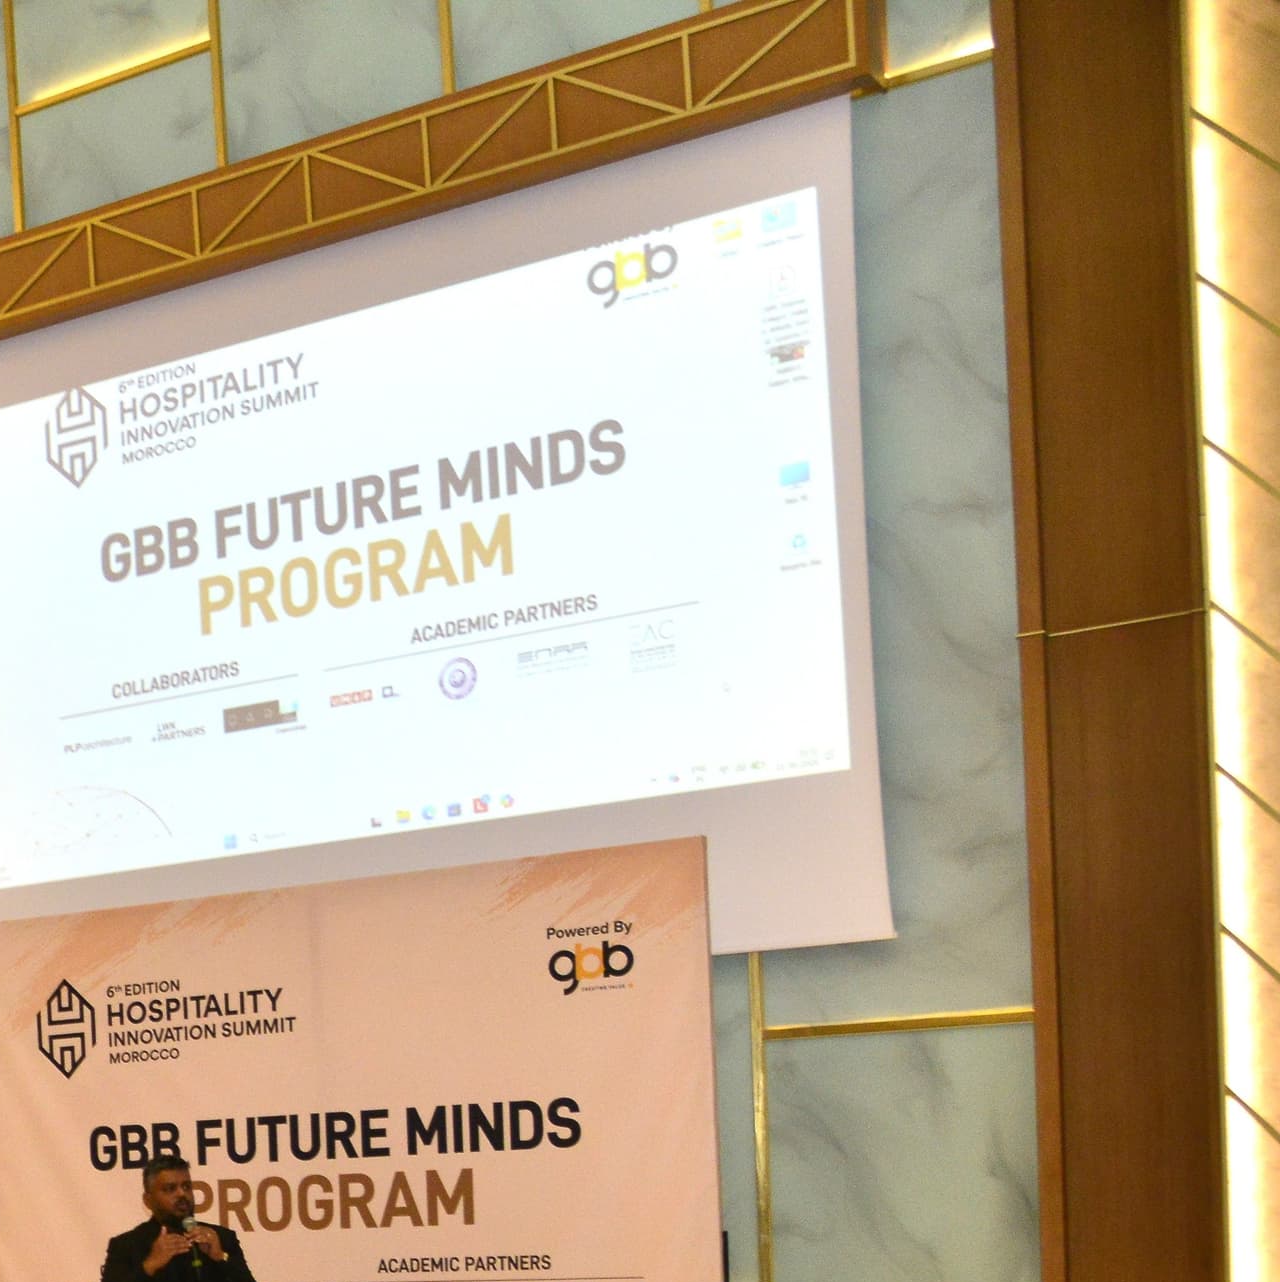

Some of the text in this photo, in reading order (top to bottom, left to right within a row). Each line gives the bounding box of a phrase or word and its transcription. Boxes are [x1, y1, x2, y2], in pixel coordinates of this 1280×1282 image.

[120, 352, 304, 424] HOSPITALITY
[138, 362, 197, 389] EDITION
[121, 382, 319, 446] INNOVATION SUMMIT
[122, 436, 197, 464] MOROCCO
[101, 419, 628, 583] GBB FUTURE MINDS
[198, 513, 515, 636] PROGRAM
[411, 595, 599, 644] ACADEMIC PARTNERS
[111, 661, 240, 699] COLLABORATORS
[546, 920, 633, 939] Powered By
[548, 941, 634, 996] gbb
[106, 979, 181, 998] 6th EDITION
[107, 988, 283, 1026] HOSPITALITY
[108, 1016, 297, 1047] INNOVATION SUMMIT
[109, 1048, 181, 1064] MOROCCO
[88, 1097, 582, 1171] GBB FUTURE MINDS
[378, 1255, 552, 1274] ACADEMIC PARTNERS
